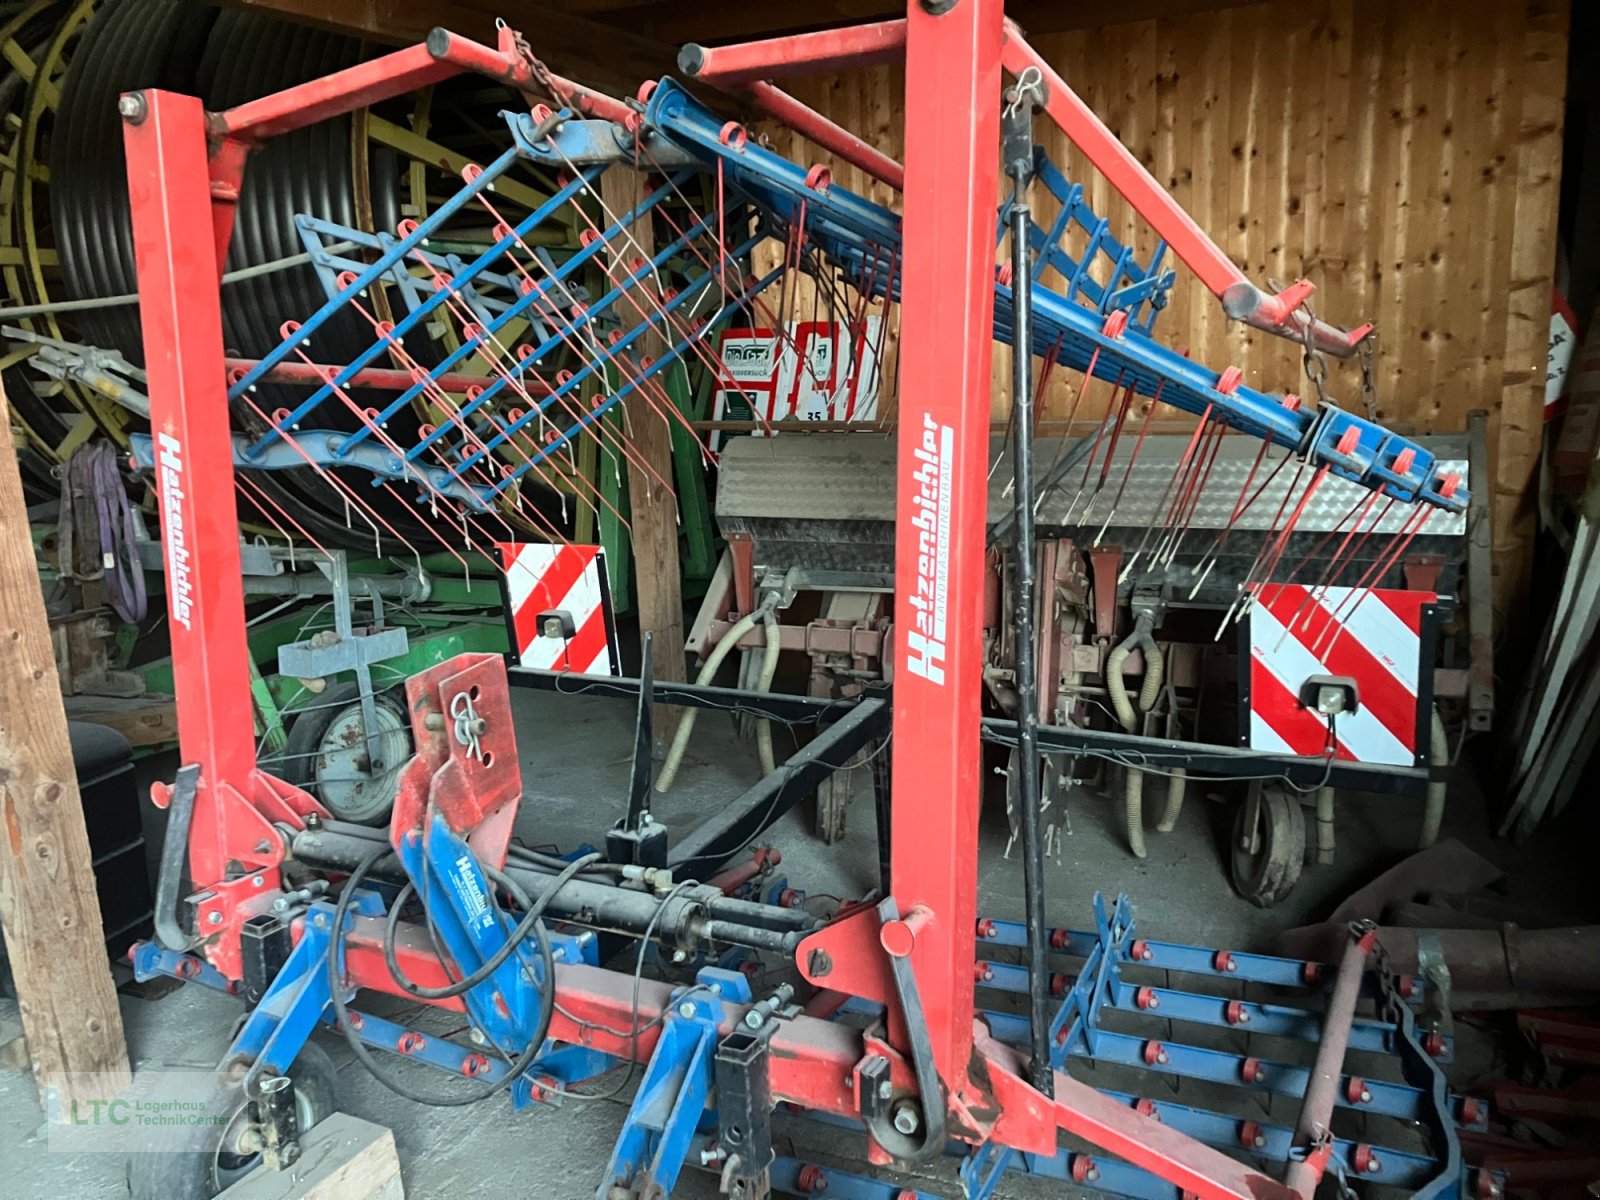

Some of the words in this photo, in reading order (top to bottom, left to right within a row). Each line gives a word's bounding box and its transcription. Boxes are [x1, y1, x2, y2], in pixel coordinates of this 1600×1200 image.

[807, 411, 821, 421] 35
[158, 431, 193, 631] Hatzenbichler
[907, 412, 946, 687] Hatzenbichler
[938, 460, 952, 624] LANDMASCHINENBAU
